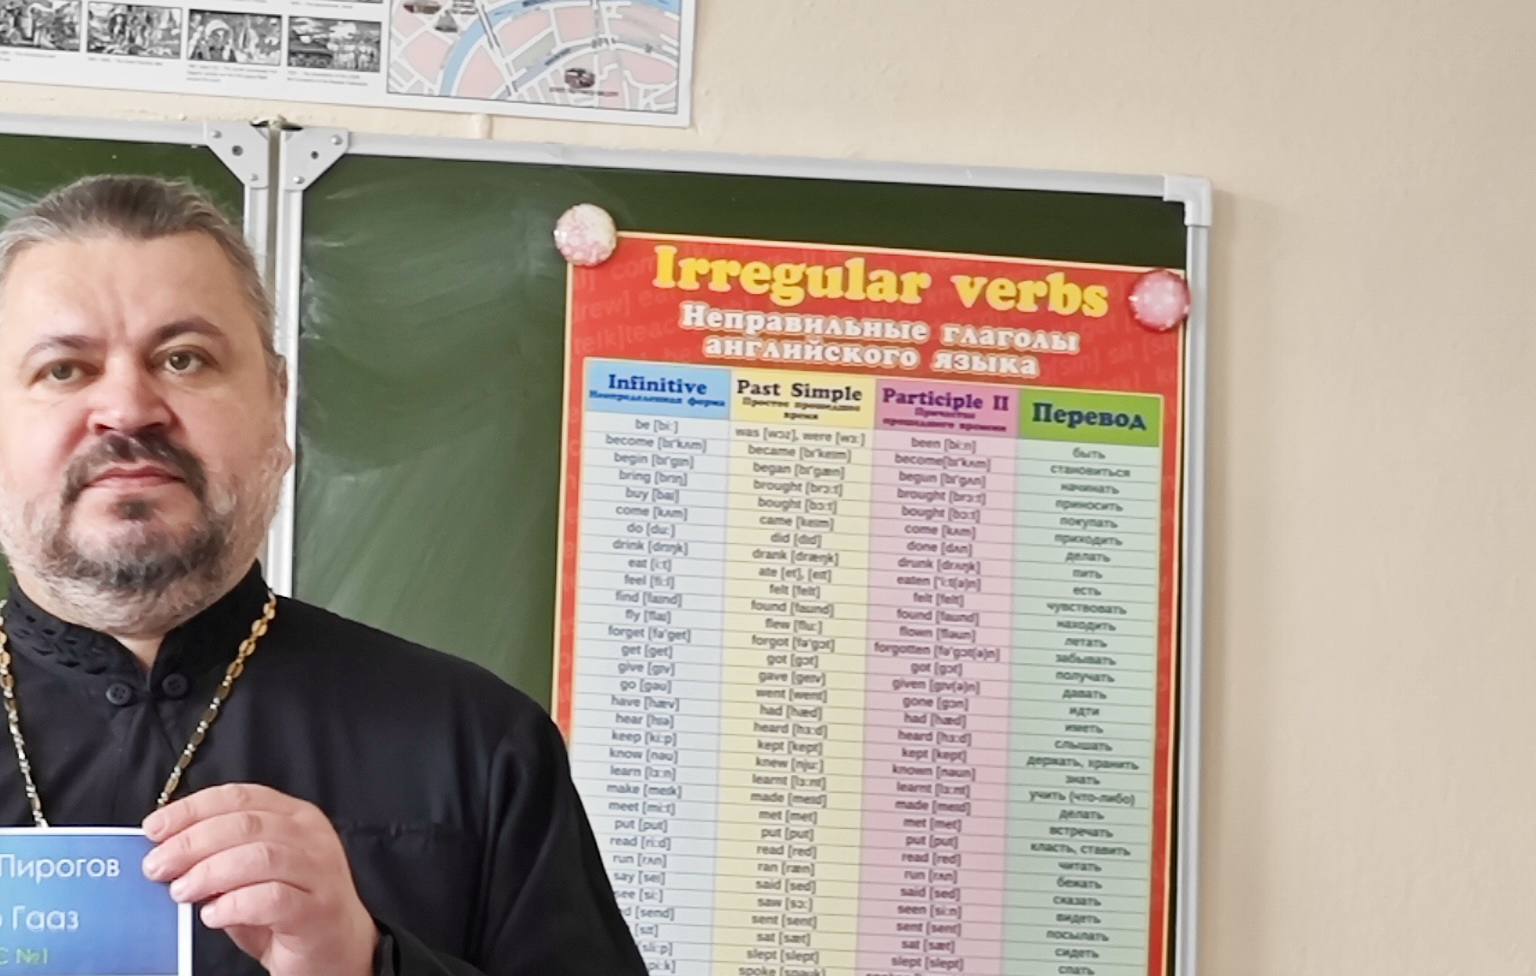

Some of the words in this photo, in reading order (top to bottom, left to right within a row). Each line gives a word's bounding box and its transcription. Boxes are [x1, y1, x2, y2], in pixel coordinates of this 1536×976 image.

[653, 245, 931, 307] Irregular
[950, 271, 1109, 317] verbs
[681, 302, 928, 341] Неправильные
[942, 324, 1080, 354] глаголы
[705, 336, 919, 368] английского
[932, 351, 1039, 377] языка
[608, 374, 708, 396] Infinitive
[736, 379, 781, 397] Past
[790, 382, 863, 403] Simple
[882, 388, 983, 412] Participle
[993, 394, 1010, 412] II
[635, 417, 650, 430] be
[1031, 402, 1148, 431] Перевод
[735, 426, 761, 438] was
[802, 431, 833, 442] were
[605, 433, 654, 448] become
[911, 435, 942, 449] been
[747, 442, 796, 457] became
[614, 451, 649, 467] begin
[752, 460, 792, 477] began
[618, 468, 652, 484] bring
[898, 469, 938, 486] begun
[753, 478, 803, 494] brought
[625, 486, 649, 502] buy
[897, 487, 946, 503] brought
[757, 495, 802, 512] bought
[615, 505, 650, 517] come
[901, 504, 946, 521] bought
[626, 521, 644, 533] do
[758, 514, 793, 526] came
[904, 523, 939, 535] come
[770, 530, 791, 543] did
[612, 537, 645, 551] drink
[906, 539, 938, 552] done
[751, 547, 788, 561] drank
[628, 556, 648, 568] eat
[897, 555, 934, 569] drunk
[624, 573, 647, 586] feel
[615, 590, 640, 603] find
[751, 599, 788, 612] found
[625, 607, 641, 622] fly
[896, 607, 933, 621] found
[608, 624, 645, 640] forget
[751, 633, 790, 649] forgot
[621, 642, 642, 657] get
[874, 641, 931, 657] forgotten
[766, 652, 788, 667] got
[617, 660, 645, 675] give
[910, 660, 932, 675] got
[758, 670, 789, 684] gave
[619, 679, 637, 692] go
[755, 686, 787, 699] went
[611, 694, 641, 707] have
[902, 696, 934, 710] gone
[759, 703, 784, 716] had
[615, 712, 643, 725] hear
[903, 711, 928, 724] had
[753, 720, 790, 734] heard
[611, 729, 642, 745] keep
[897, 728, 934, 742] heard
[609, 746, 643, 759] know
[757, 738, 785, 753] kept
[901, 746, 929, 761] kept
[755, 755, 789, 768] knew
[610, 764, 642, 777] learn
[892, 763, 934, 776] known
[751, 772, 788, 786] learnt
[606, 781, 641, 795] make
[896, 780, 933, 793] learnt
[750, 790, 785, 803] made
[608, 798, 639, 812] meet
[894, 798, 929, 811] made
[758, 808, 783, 820] met
[614, 817, 635, 832] put
[902, 815, 927, 828] met
[760, 825, 782, 841] put
[609, 834, 638, 847] read
[905, 833, 927, 848] put
[756, 842, 785, 855] read
[612, 853, 634, 865] run
[901, 850, 930, 863] read
[757, 862, 779, 873] ran
[904, 869, 926, 880] run
[614, 871, 635, 884] say
[755, 877, 782, 890] said
[900, 885, 927, 898] said
[757, 897, 782, 908] saw
[897, 904, 927, 915] seen
[13, 905, 79, 931] Гааз
[751, 912, 779, 925] sent
[896, 919, 924, 932] sent
[746, 947, 778, 962] slept
[891, 954, 922, 970] slept
